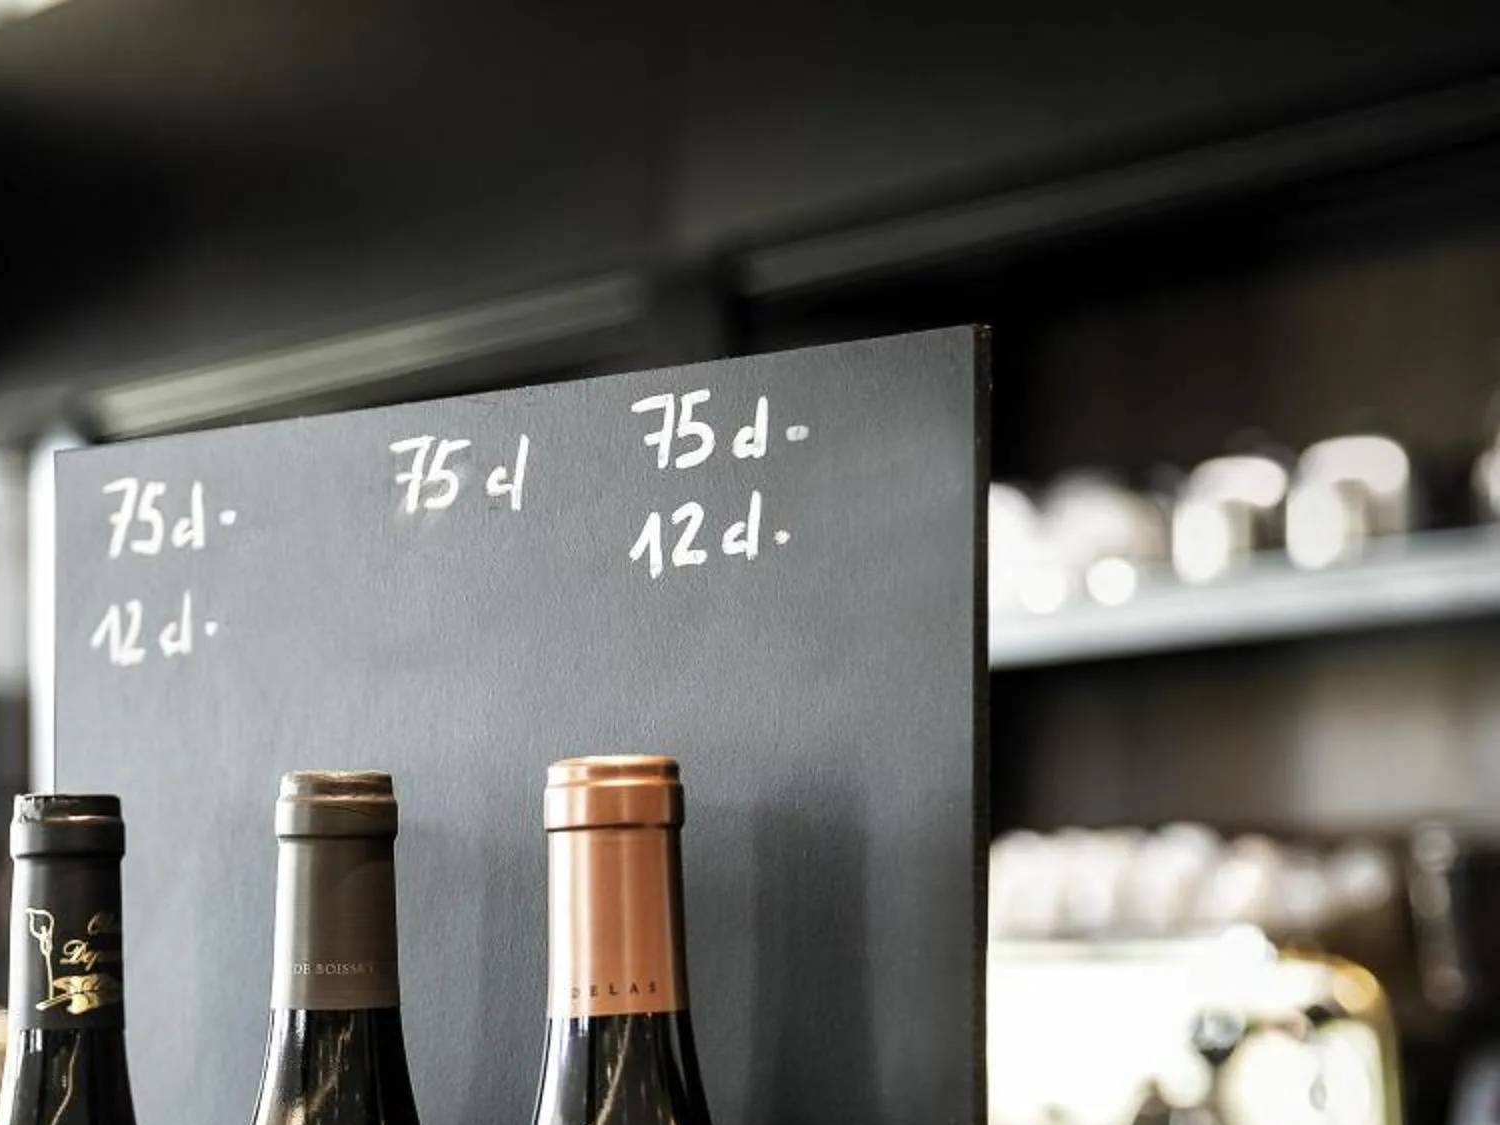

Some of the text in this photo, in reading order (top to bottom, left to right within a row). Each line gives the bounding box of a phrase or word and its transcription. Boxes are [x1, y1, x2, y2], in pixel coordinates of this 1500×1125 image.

[631, 388, 715, 469] 75
[389, 435, 471, 514] 75
[629, 502, 708, 579] 12
